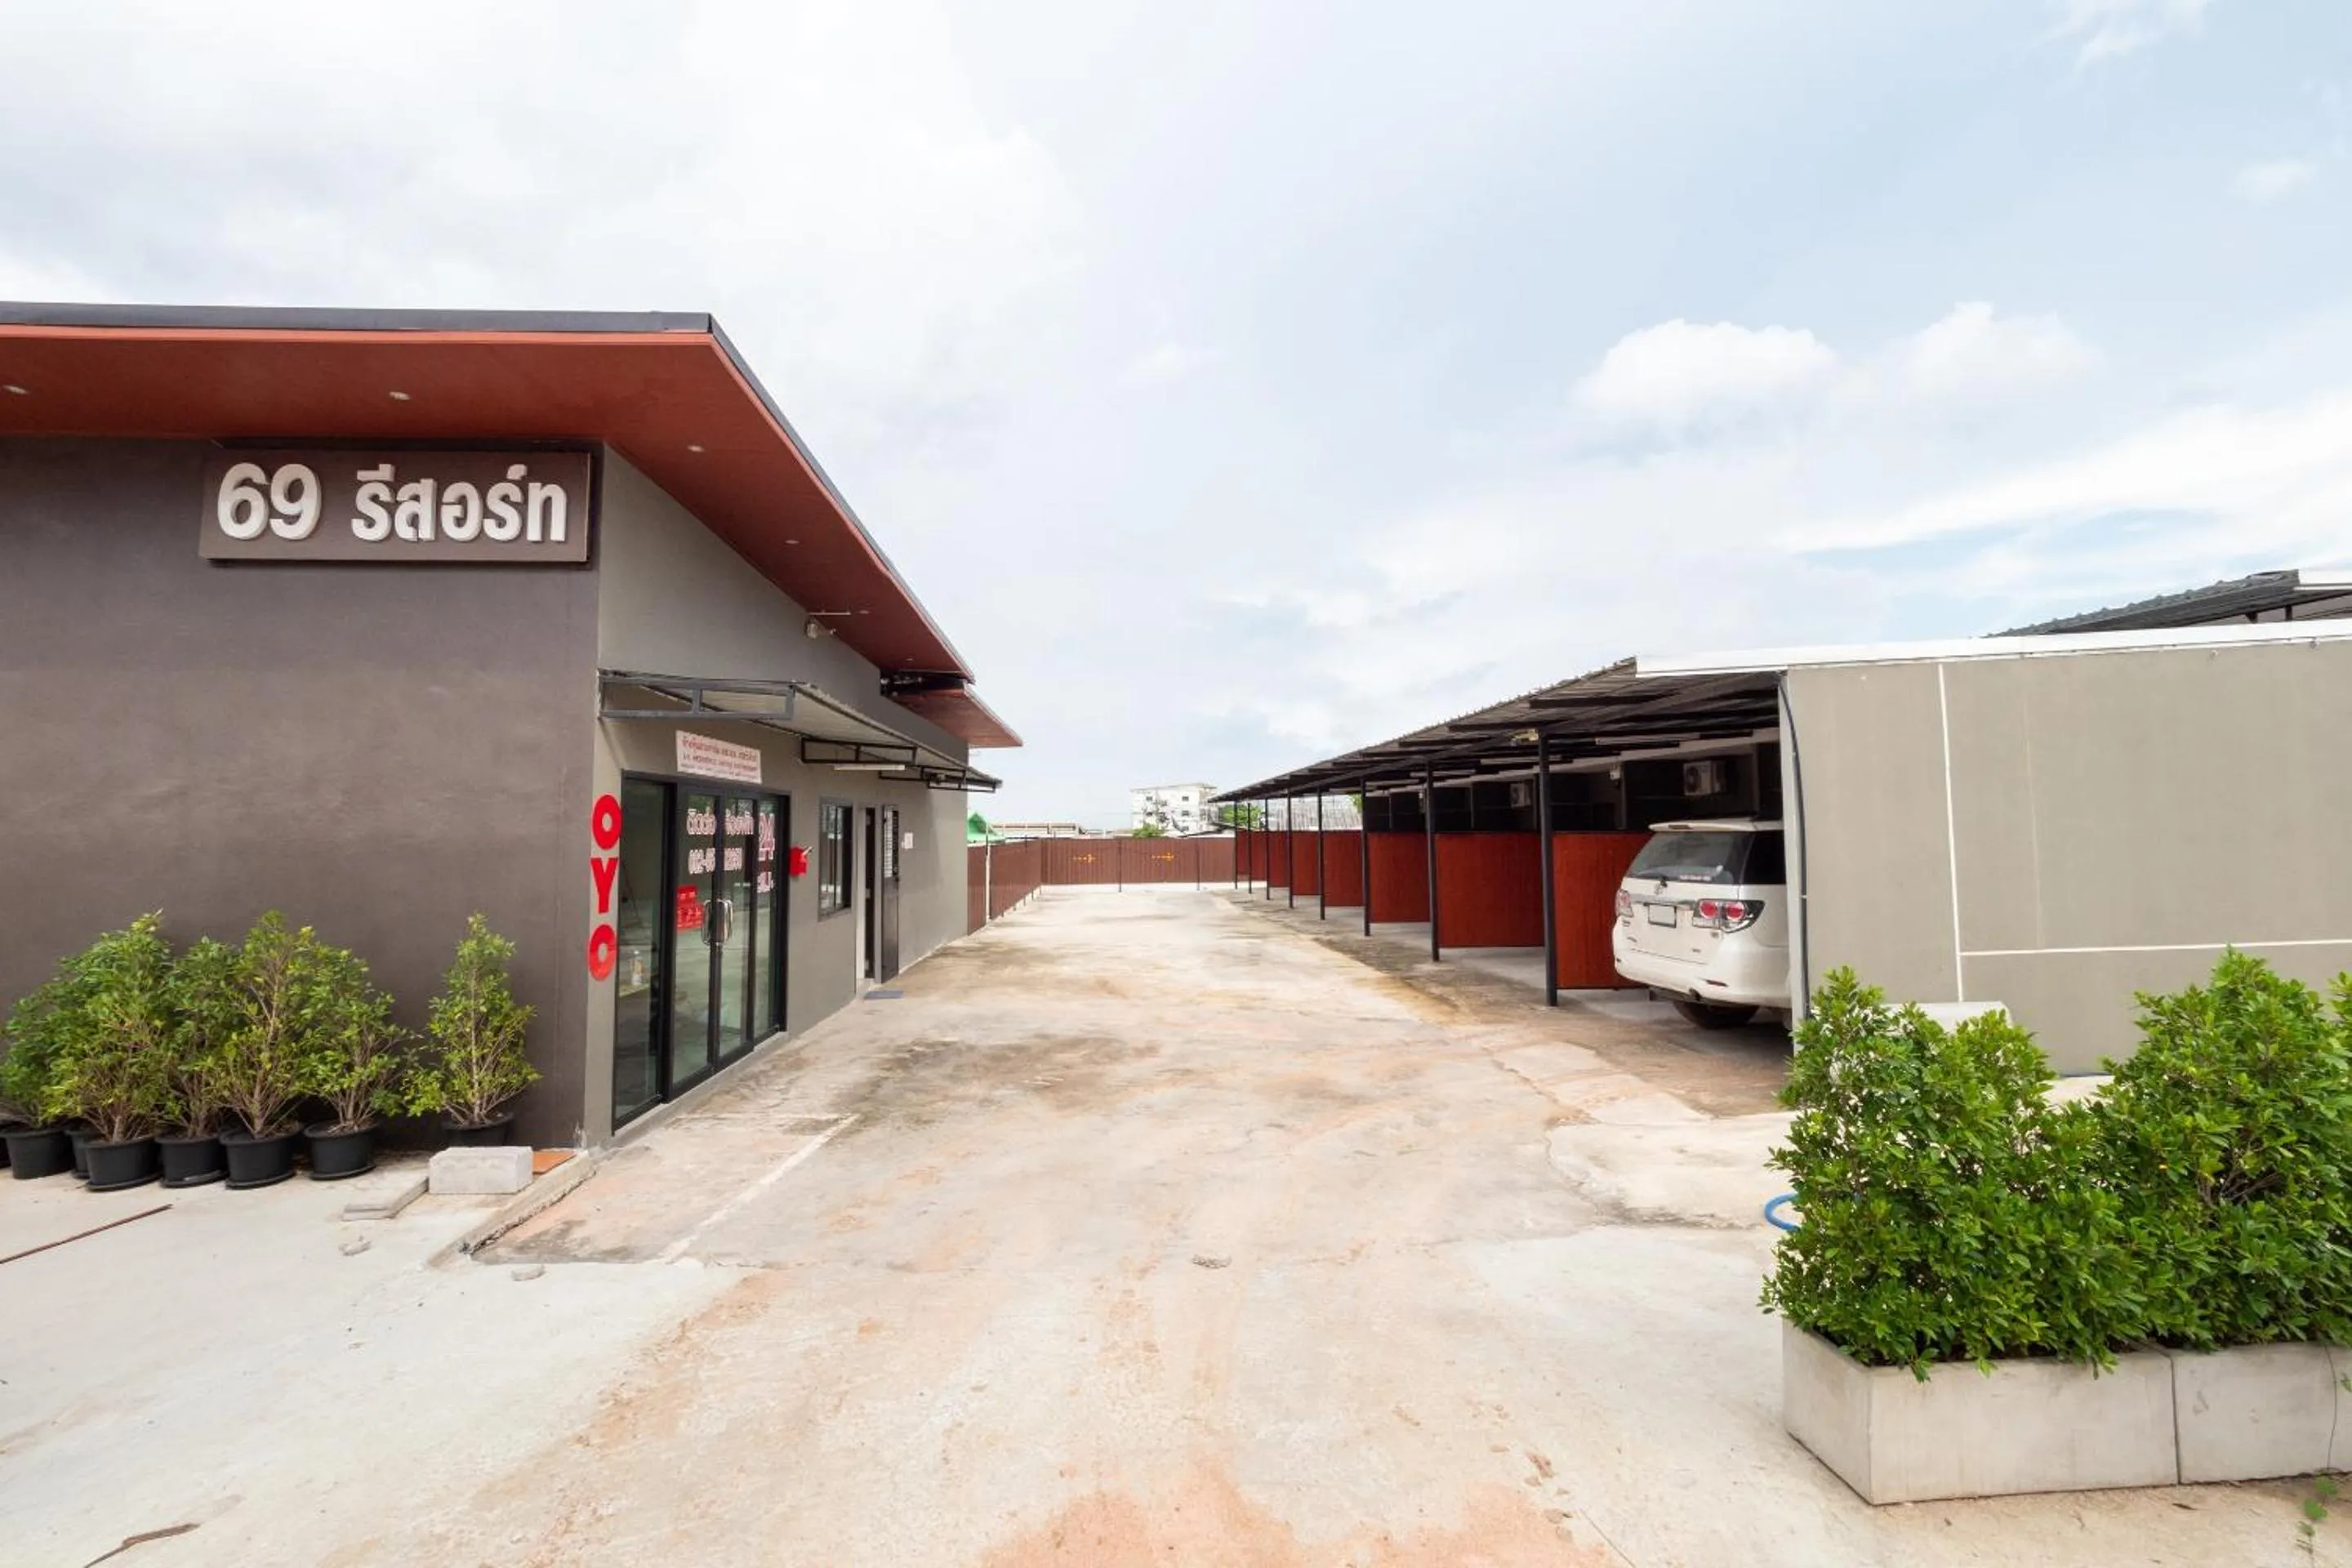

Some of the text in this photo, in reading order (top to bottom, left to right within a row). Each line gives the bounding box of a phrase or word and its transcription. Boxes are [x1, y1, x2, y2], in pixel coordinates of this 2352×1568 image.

[217, 461, 568, 542] 69 รีสอร์ท
[587, 794, 623, 981] OYO
